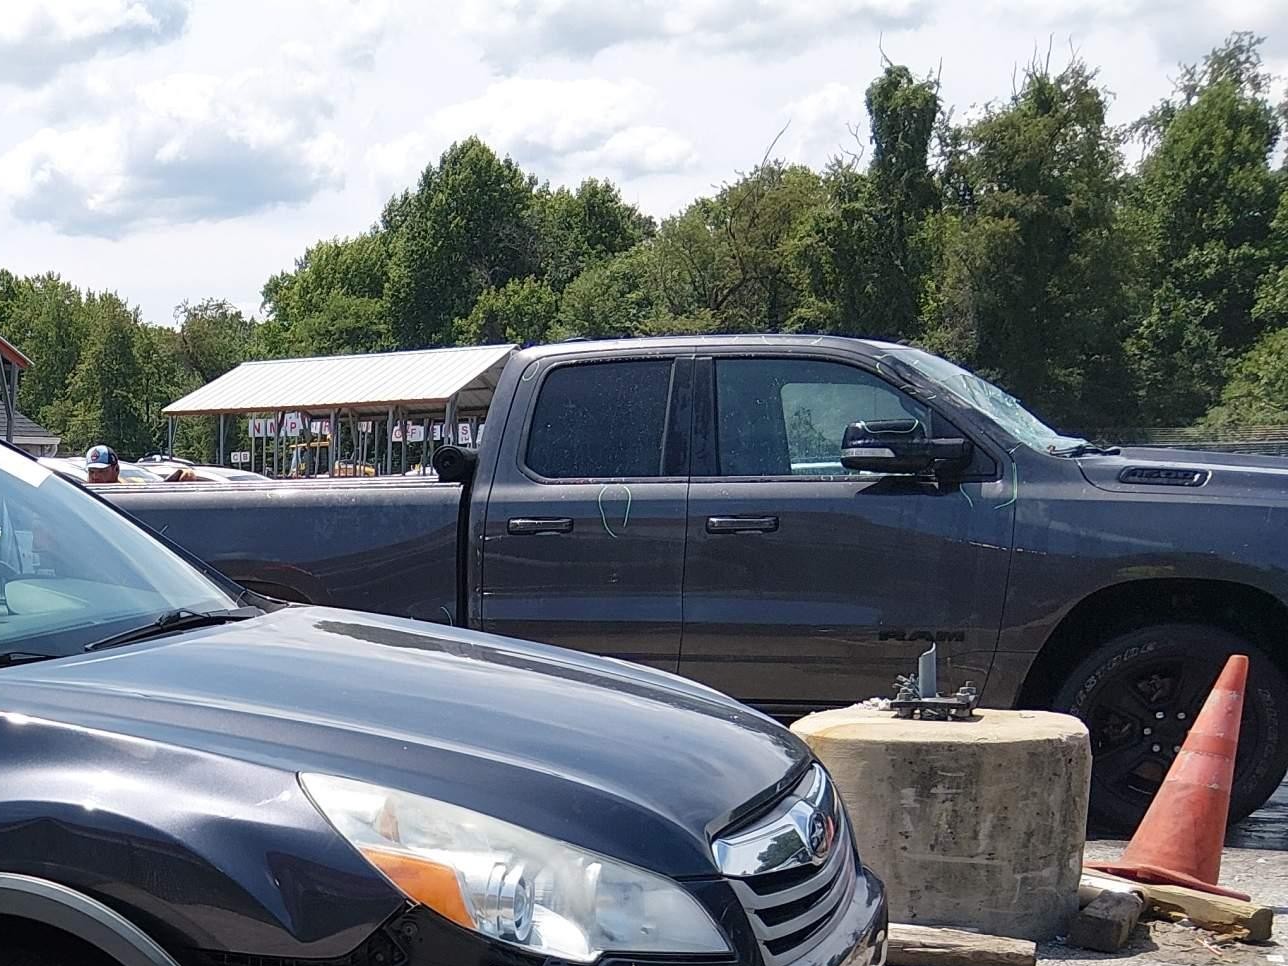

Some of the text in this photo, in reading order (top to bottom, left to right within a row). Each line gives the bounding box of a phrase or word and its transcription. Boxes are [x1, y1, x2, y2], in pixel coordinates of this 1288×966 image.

[290, 422, 297, 433] P
[461, 425, 469, 435] S
[878, 630, 965, 642] RAM
